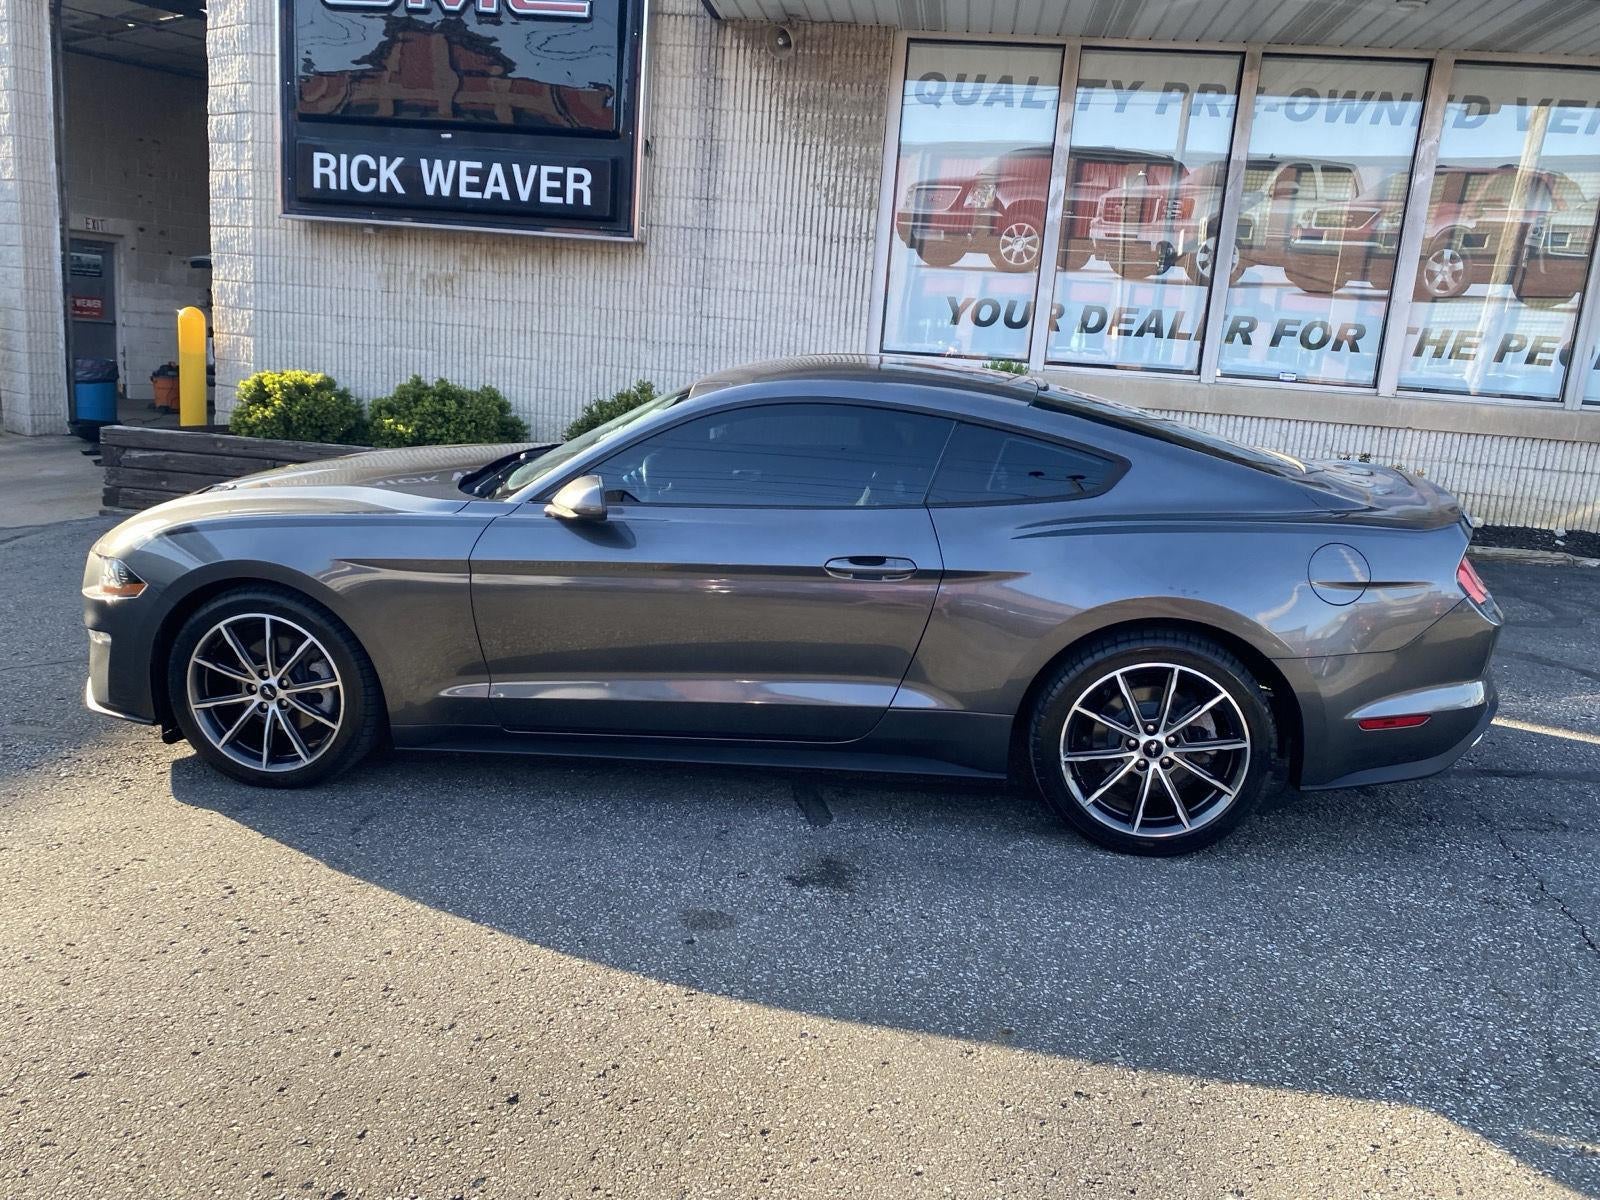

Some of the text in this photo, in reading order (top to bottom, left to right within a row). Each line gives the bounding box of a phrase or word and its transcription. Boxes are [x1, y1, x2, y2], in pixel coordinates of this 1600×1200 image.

[914, 71, 1145, 114] QUALTY
[1155, 81, 1491, 129] PR-OWND
[312, 151, 592, 206] RICK WEAVER
[86, 216, 104, 231] EXIT
[1269, 318, 1367, 353] FOR
